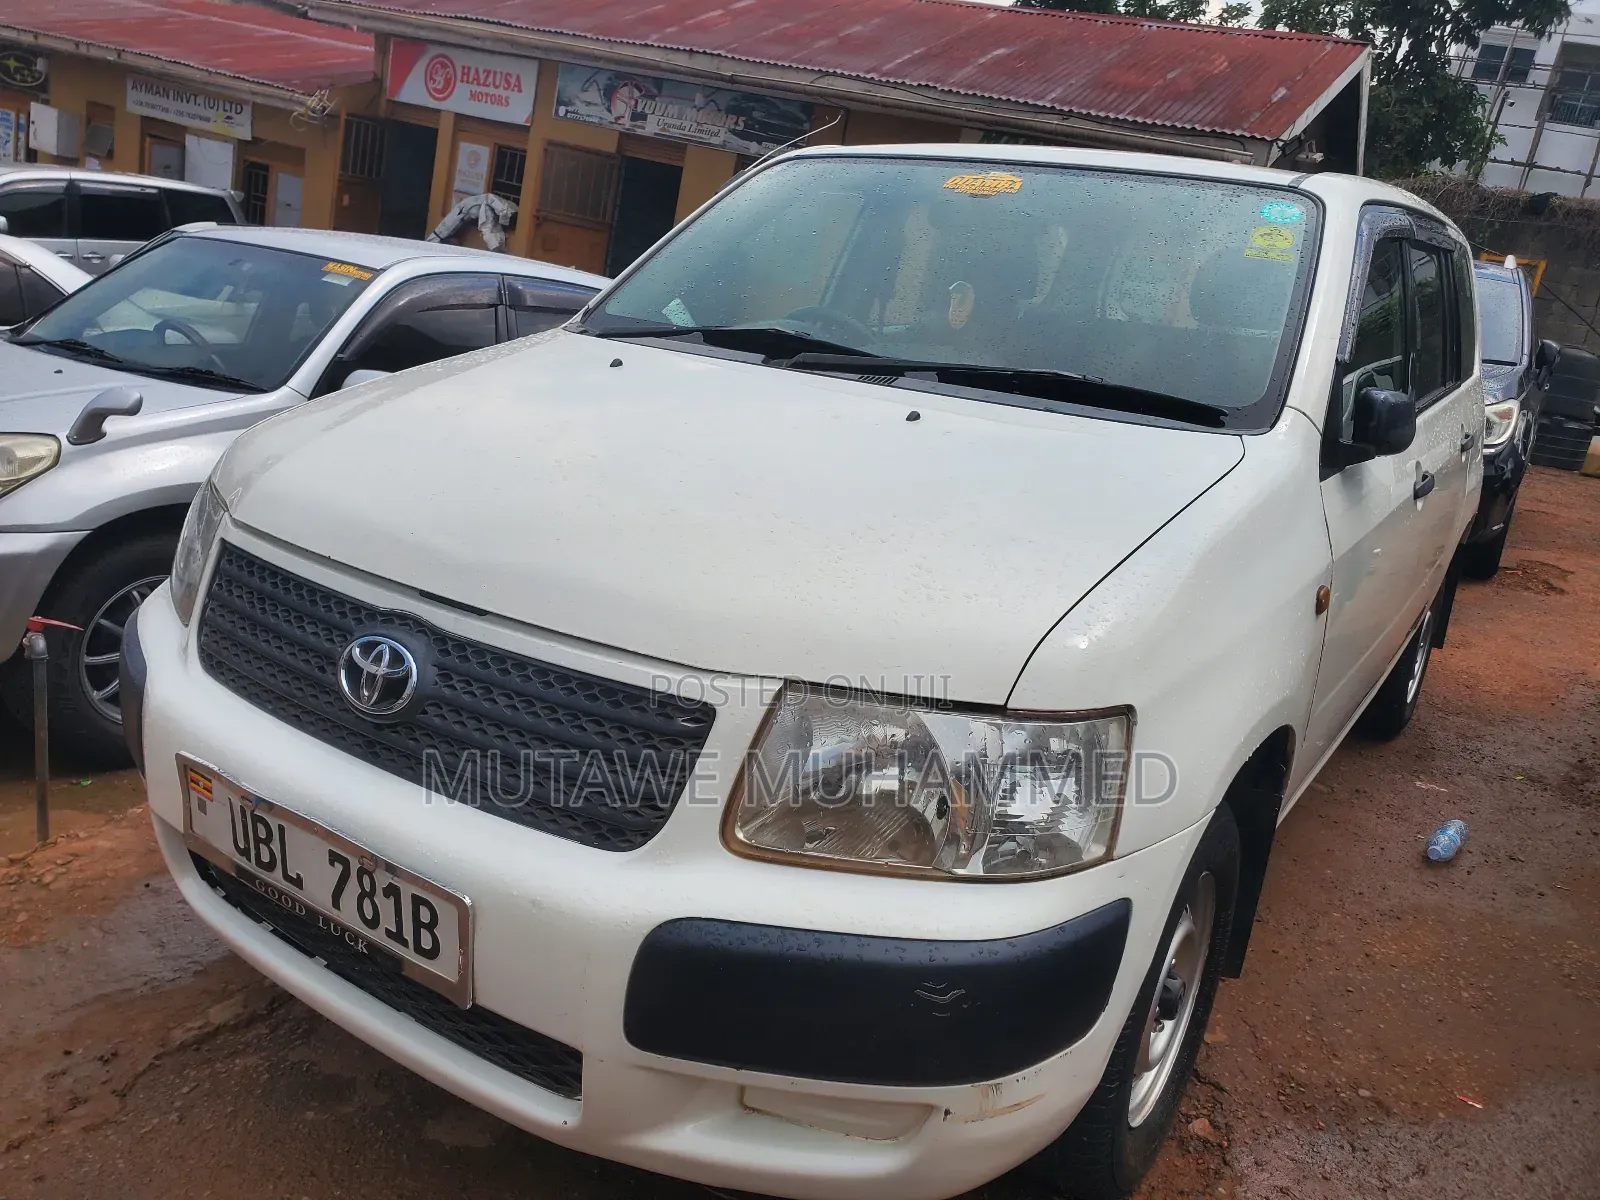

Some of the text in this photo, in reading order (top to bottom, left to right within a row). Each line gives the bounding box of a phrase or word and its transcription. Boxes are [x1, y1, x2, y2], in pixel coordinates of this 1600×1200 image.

[460, 65, 523, 94] HAZUSA
[131, 81, 170, 100] AYMAN
[172, 89, 201, 107] INVT.
[203, 95, 220, 112] (U)
[222, 101, 244, 115] LTD
[468, 89, 510, 108] MOTORS
[656, 118, 721, 138] Uganda Limited.
[227, 796, 441, 961] UBL 781B
[255, 878, 369, 955] GOOD LUCK
